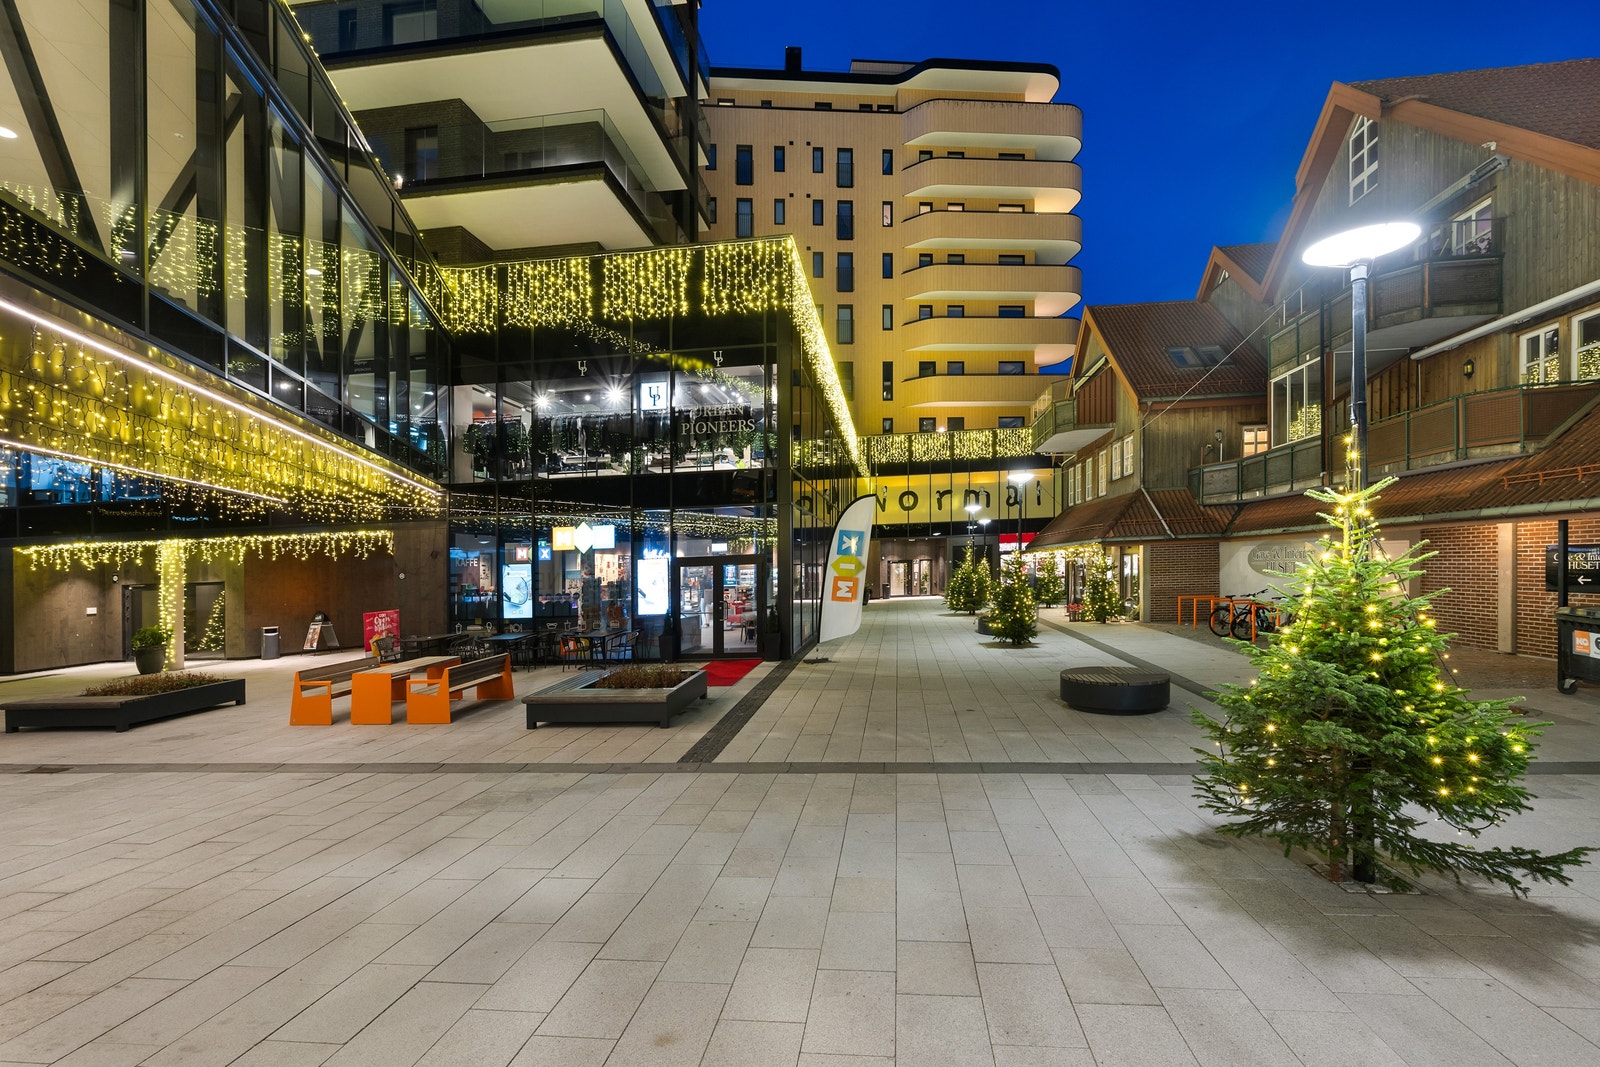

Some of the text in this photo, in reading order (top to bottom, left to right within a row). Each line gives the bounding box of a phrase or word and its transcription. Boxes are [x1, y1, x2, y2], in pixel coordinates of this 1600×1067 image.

[692, 403, 744, 418] URBAN
[681, 418, 756, 435] PIONEERS
[876, 480, 1042, 512] Normal
[455, 558, 479, 567] KAFFE
[836, 535, 859, 598] MIX
[1568, 561, 1600, 570] HUSET
